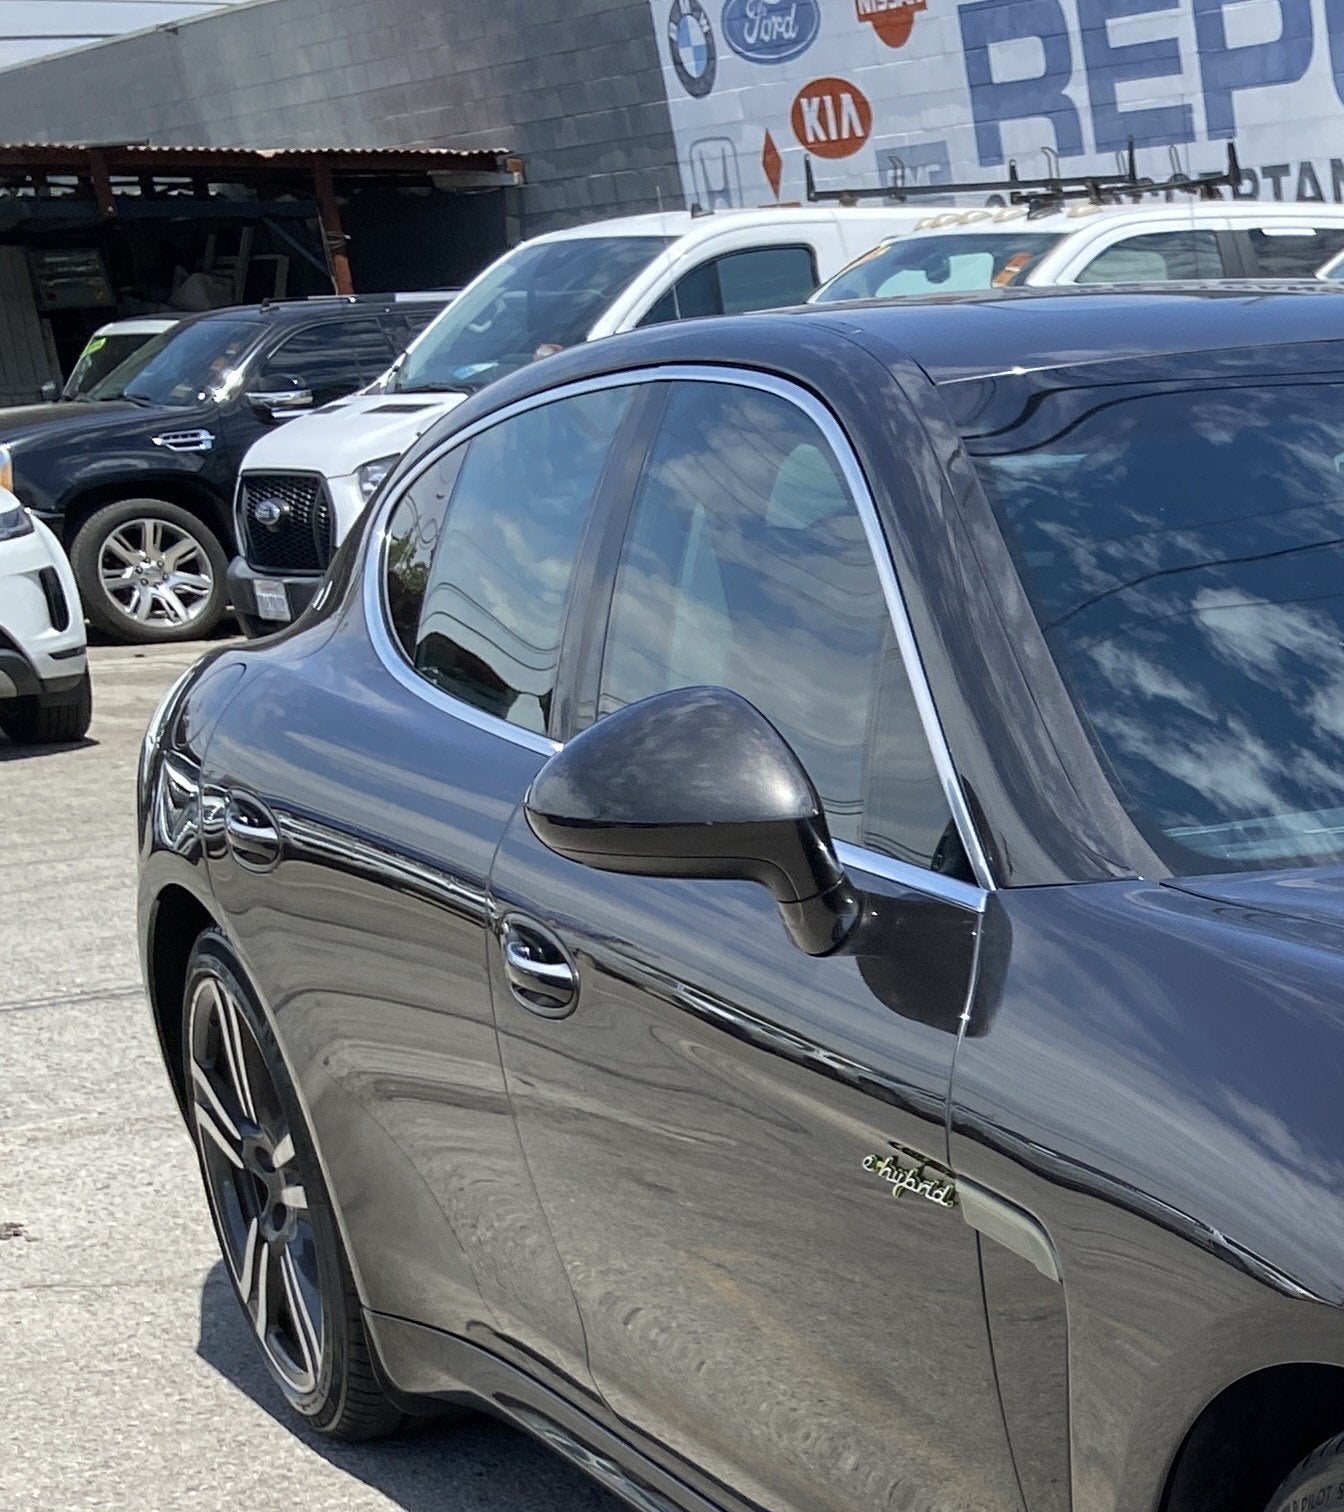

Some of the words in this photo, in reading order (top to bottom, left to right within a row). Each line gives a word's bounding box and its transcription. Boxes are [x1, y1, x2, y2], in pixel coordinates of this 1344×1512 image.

[743, 0, 798, 45] Ford
[801, 92, 866, 144] KIA
[1300, 1485, 1333, 1512] PILOT
